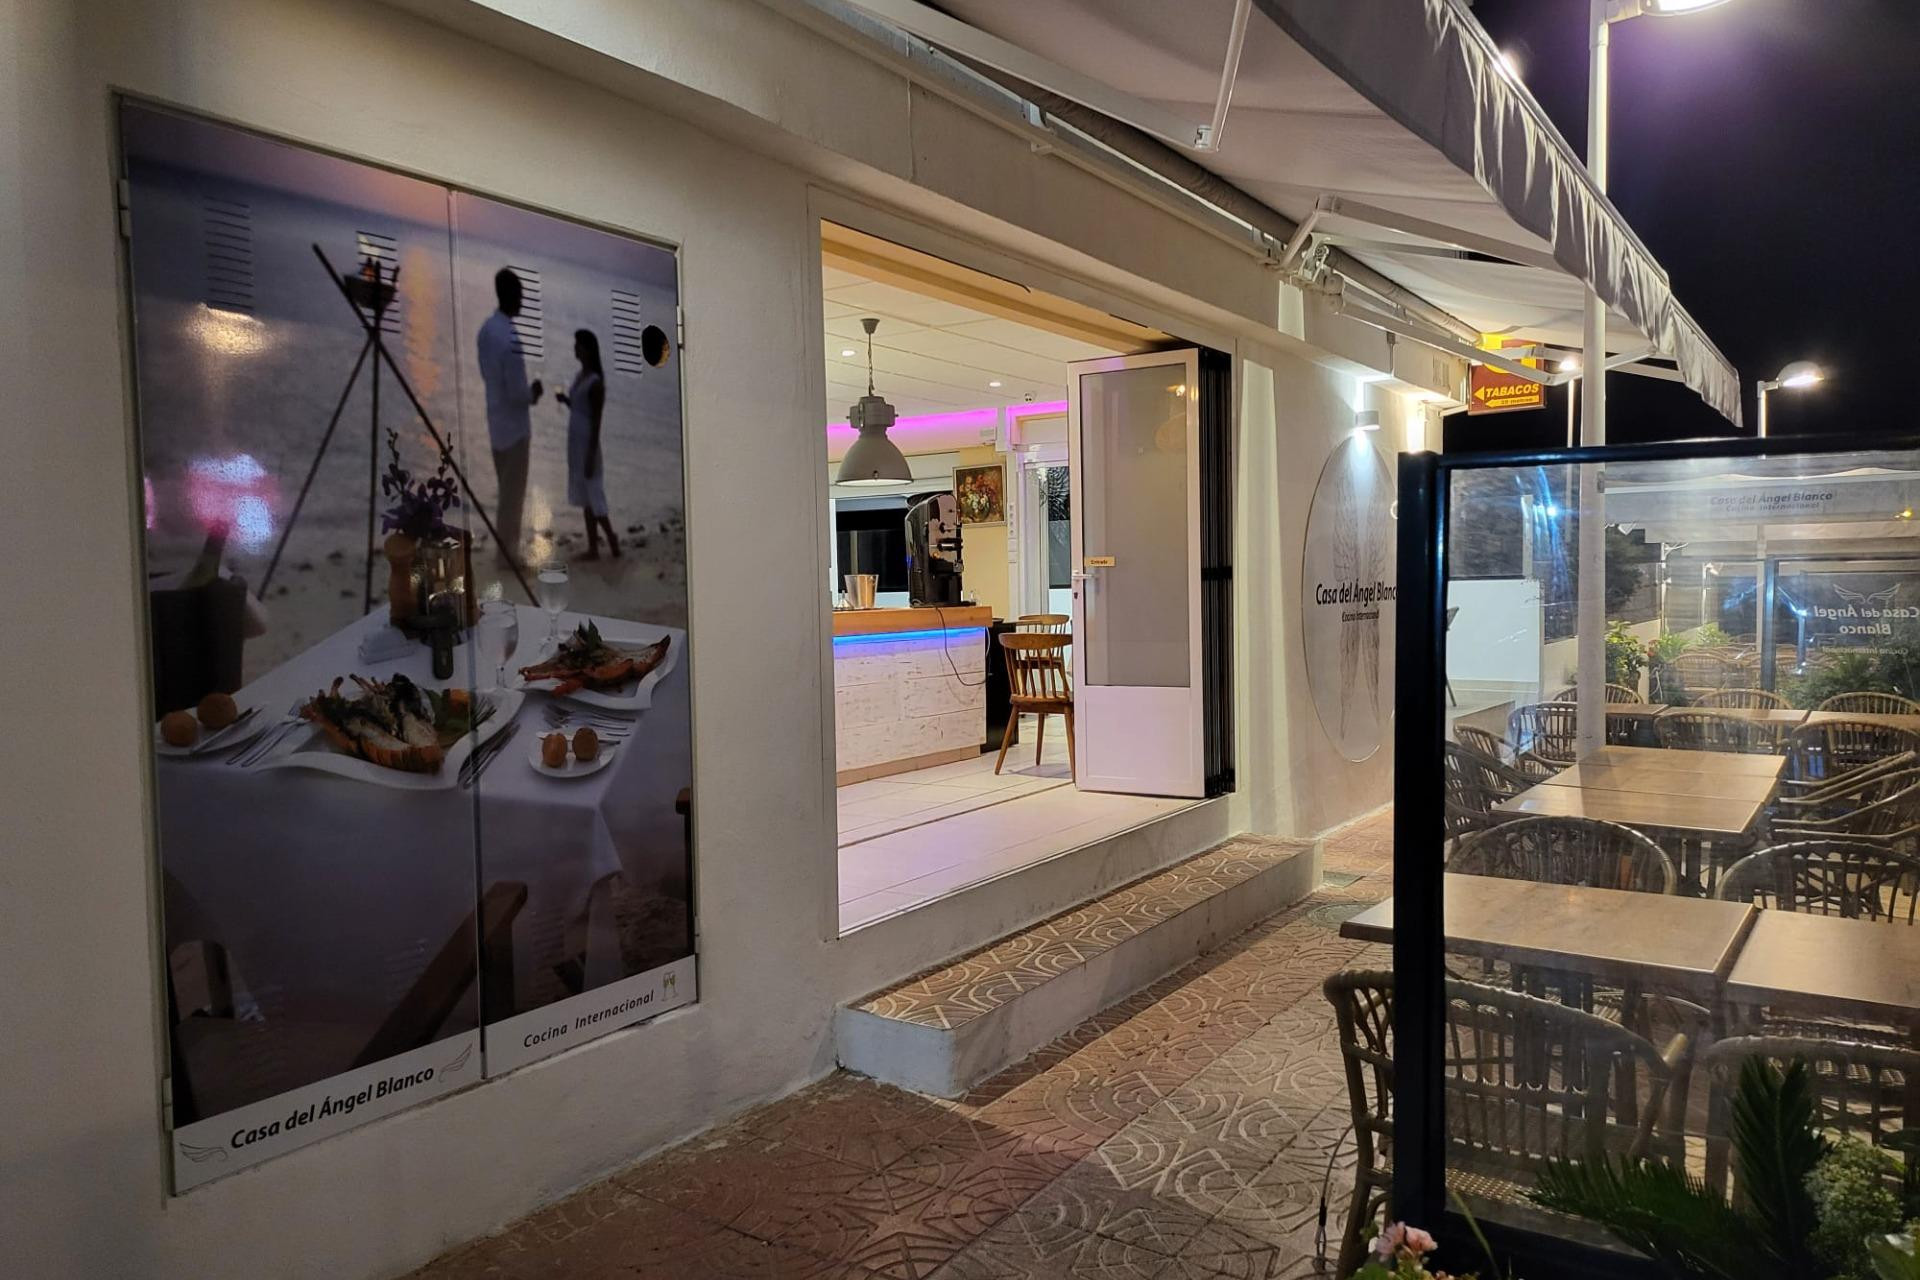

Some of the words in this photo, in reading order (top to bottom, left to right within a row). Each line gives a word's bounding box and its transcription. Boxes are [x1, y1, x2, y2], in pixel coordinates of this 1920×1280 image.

[1485, 383, 1540, 398] TABACOS
[1793, 491, 1833, 503] Blanco
[1316, 583, 1338, 605] Casa
[1339, 582, 1353, 604] del
[1353, 578, 1377, 608] Ángel
[1377, 581, 1397, 601] Blanc
[523, 1023, 568, 1048] Cocina
[575, 989, 655, 1029] Internacional
[231, 1122, 280, 1149] Casa
[285, 1105, 315, 1131] del
[318, 1084, 373, 1118] Ángel
[376, 1067, 435, 1098] Blanco
